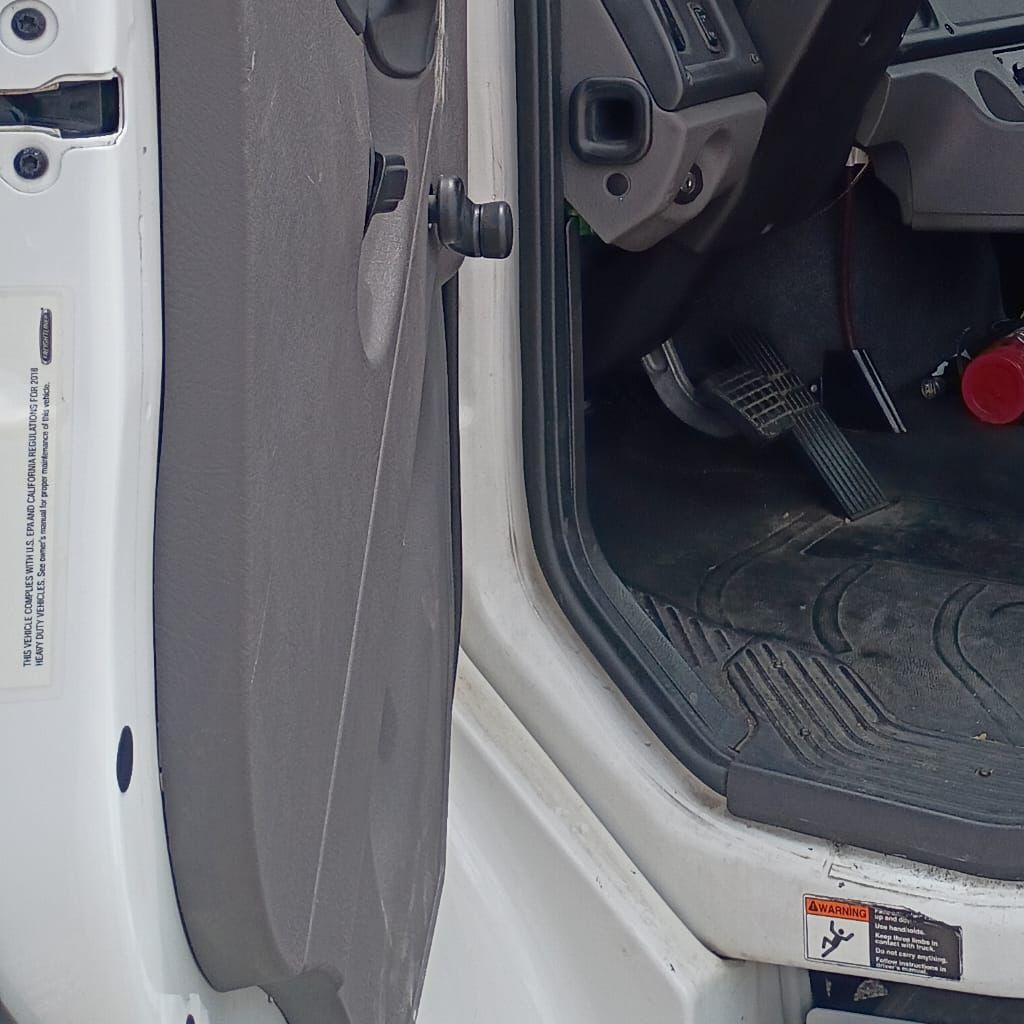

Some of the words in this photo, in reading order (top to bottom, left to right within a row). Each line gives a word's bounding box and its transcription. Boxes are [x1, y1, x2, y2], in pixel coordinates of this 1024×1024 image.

[30, 387, 38, 402] FOR
[28, 404, 38, 457] REGULATIONS
[27, 458, 36, 504] CALIFORNIA
[27, 505, 35, 520] AND
[26, 521, 34, 536] EPA
[26, 540, 34, 552] U.S.
[38, 536, 46, 562] owner's
[25, 554, 34, 574] WITH
[37, 564, 45, 577] See
[24, 576, 34, 614] COMPLIES
[36, 578, 45, 617] VEHICLES.
[24, 616, 32, 648] VEHICLE
[36, 620, 44, 640] DUTY
[23, 650, 32, 666] THIS
[35, 642, 44, 666] HEAVY
[818, 904, 866, 918] WARNING
[899, 960, 938, 971] instructions
